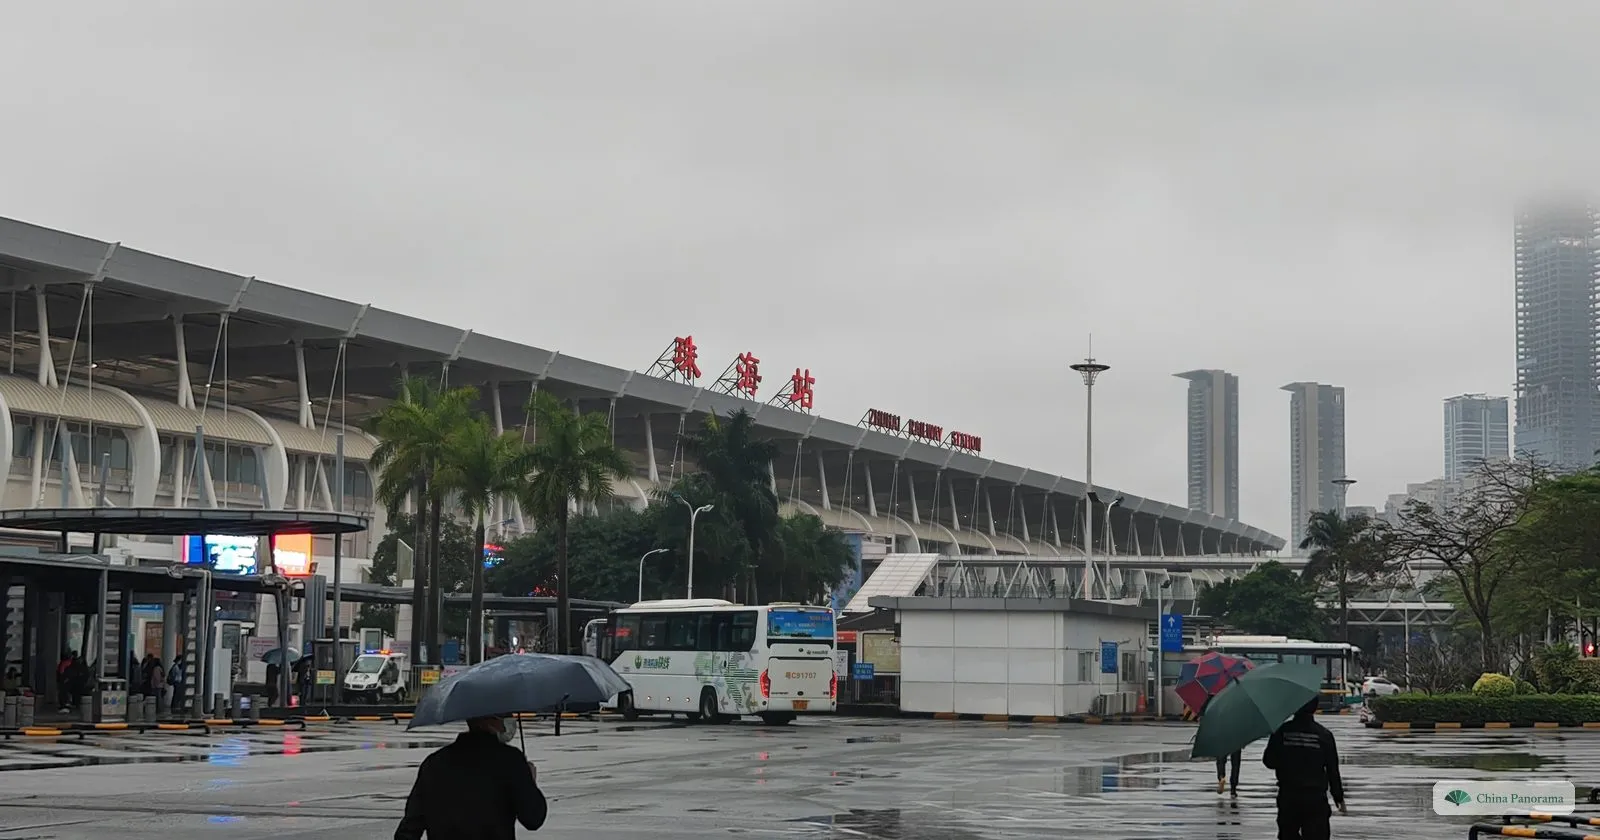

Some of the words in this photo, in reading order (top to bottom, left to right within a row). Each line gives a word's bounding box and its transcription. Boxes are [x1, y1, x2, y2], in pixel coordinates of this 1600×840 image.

[673, 335, 815, 409] 珠海站
[869, 408, 901, 432] ZHUHAI
[908, 418, 943, 442] RAILWAY
[951, 430, 982, 452] STATION
